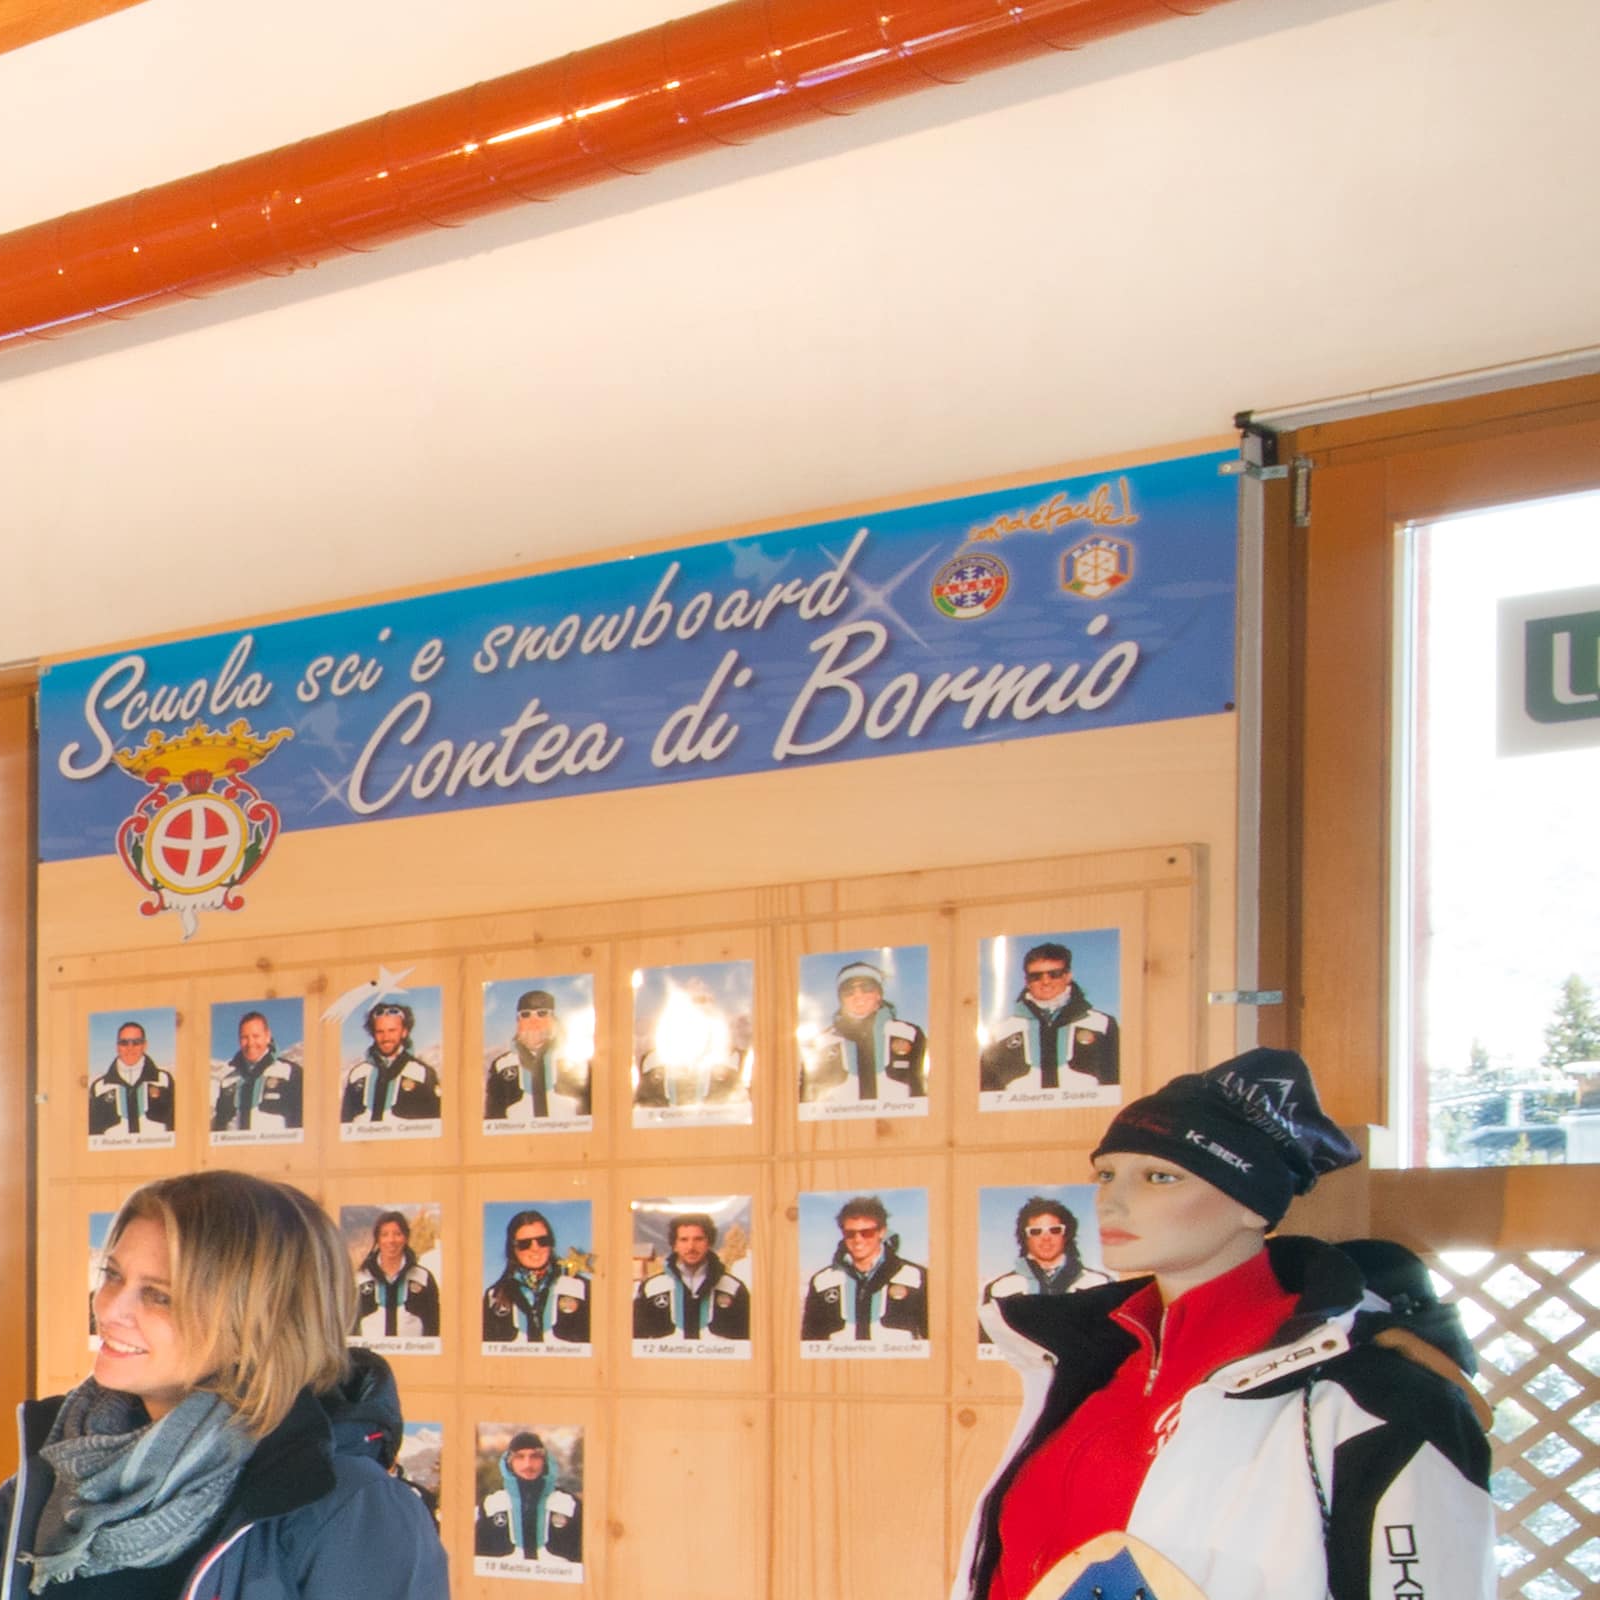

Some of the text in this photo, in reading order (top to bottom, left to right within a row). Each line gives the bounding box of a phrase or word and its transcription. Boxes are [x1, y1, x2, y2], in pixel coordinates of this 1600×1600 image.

[58, 528, 869, 780] Scuola sci e snowboard
[347, 614, 1140, 815] Contea di Bormio
